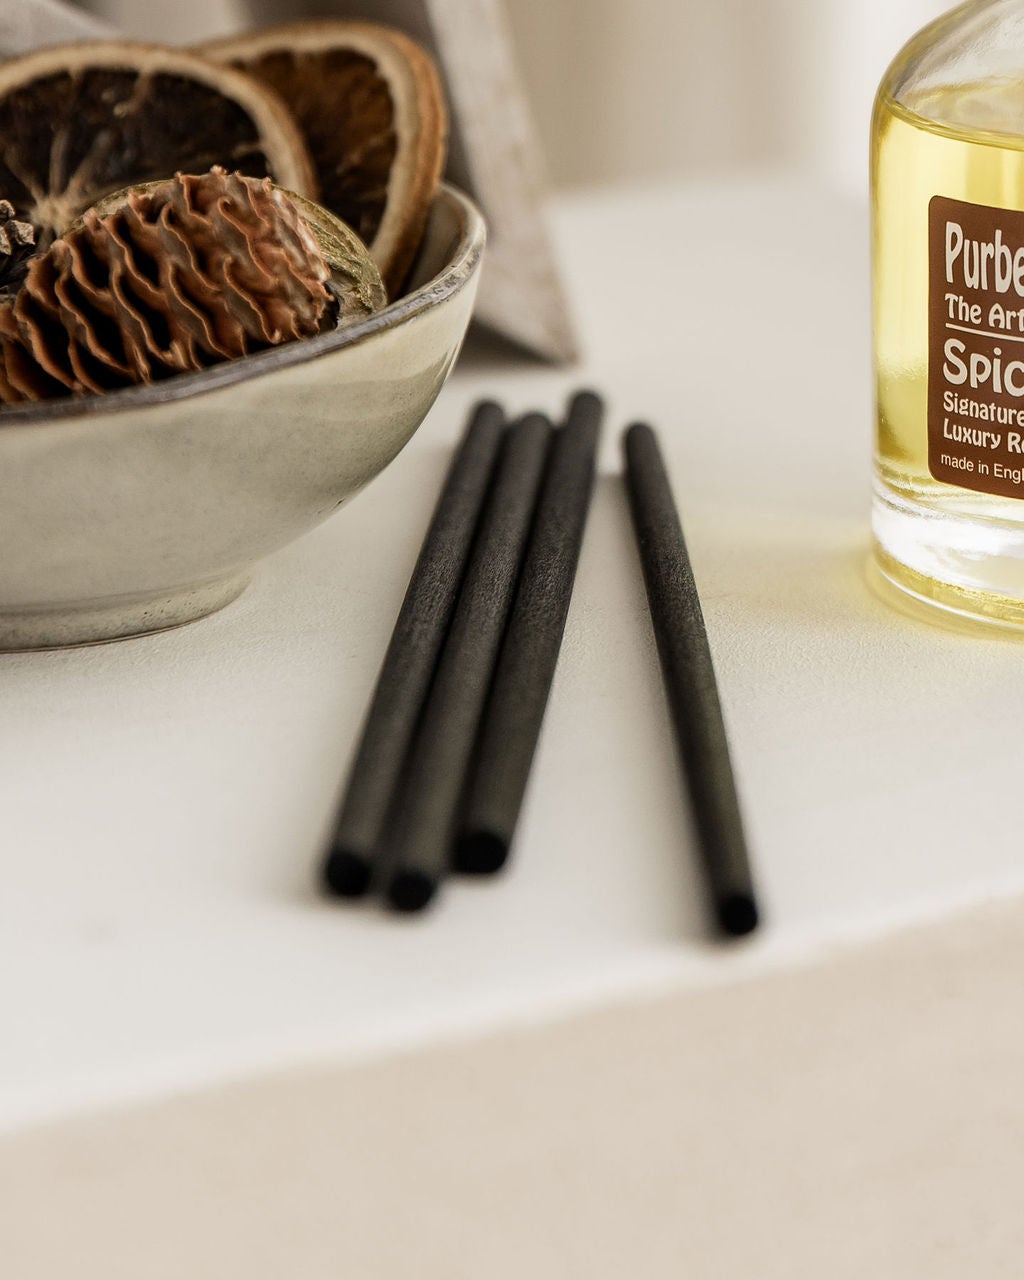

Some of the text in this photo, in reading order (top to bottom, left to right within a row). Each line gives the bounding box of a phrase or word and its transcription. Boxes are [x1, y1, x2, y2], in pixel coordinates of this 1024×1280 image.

[945, 293, 981, 324] The
[944, 418, 1001, 449] Luxury
[941, 454, 974, 471] made
[978, 460, 989, 475] in
